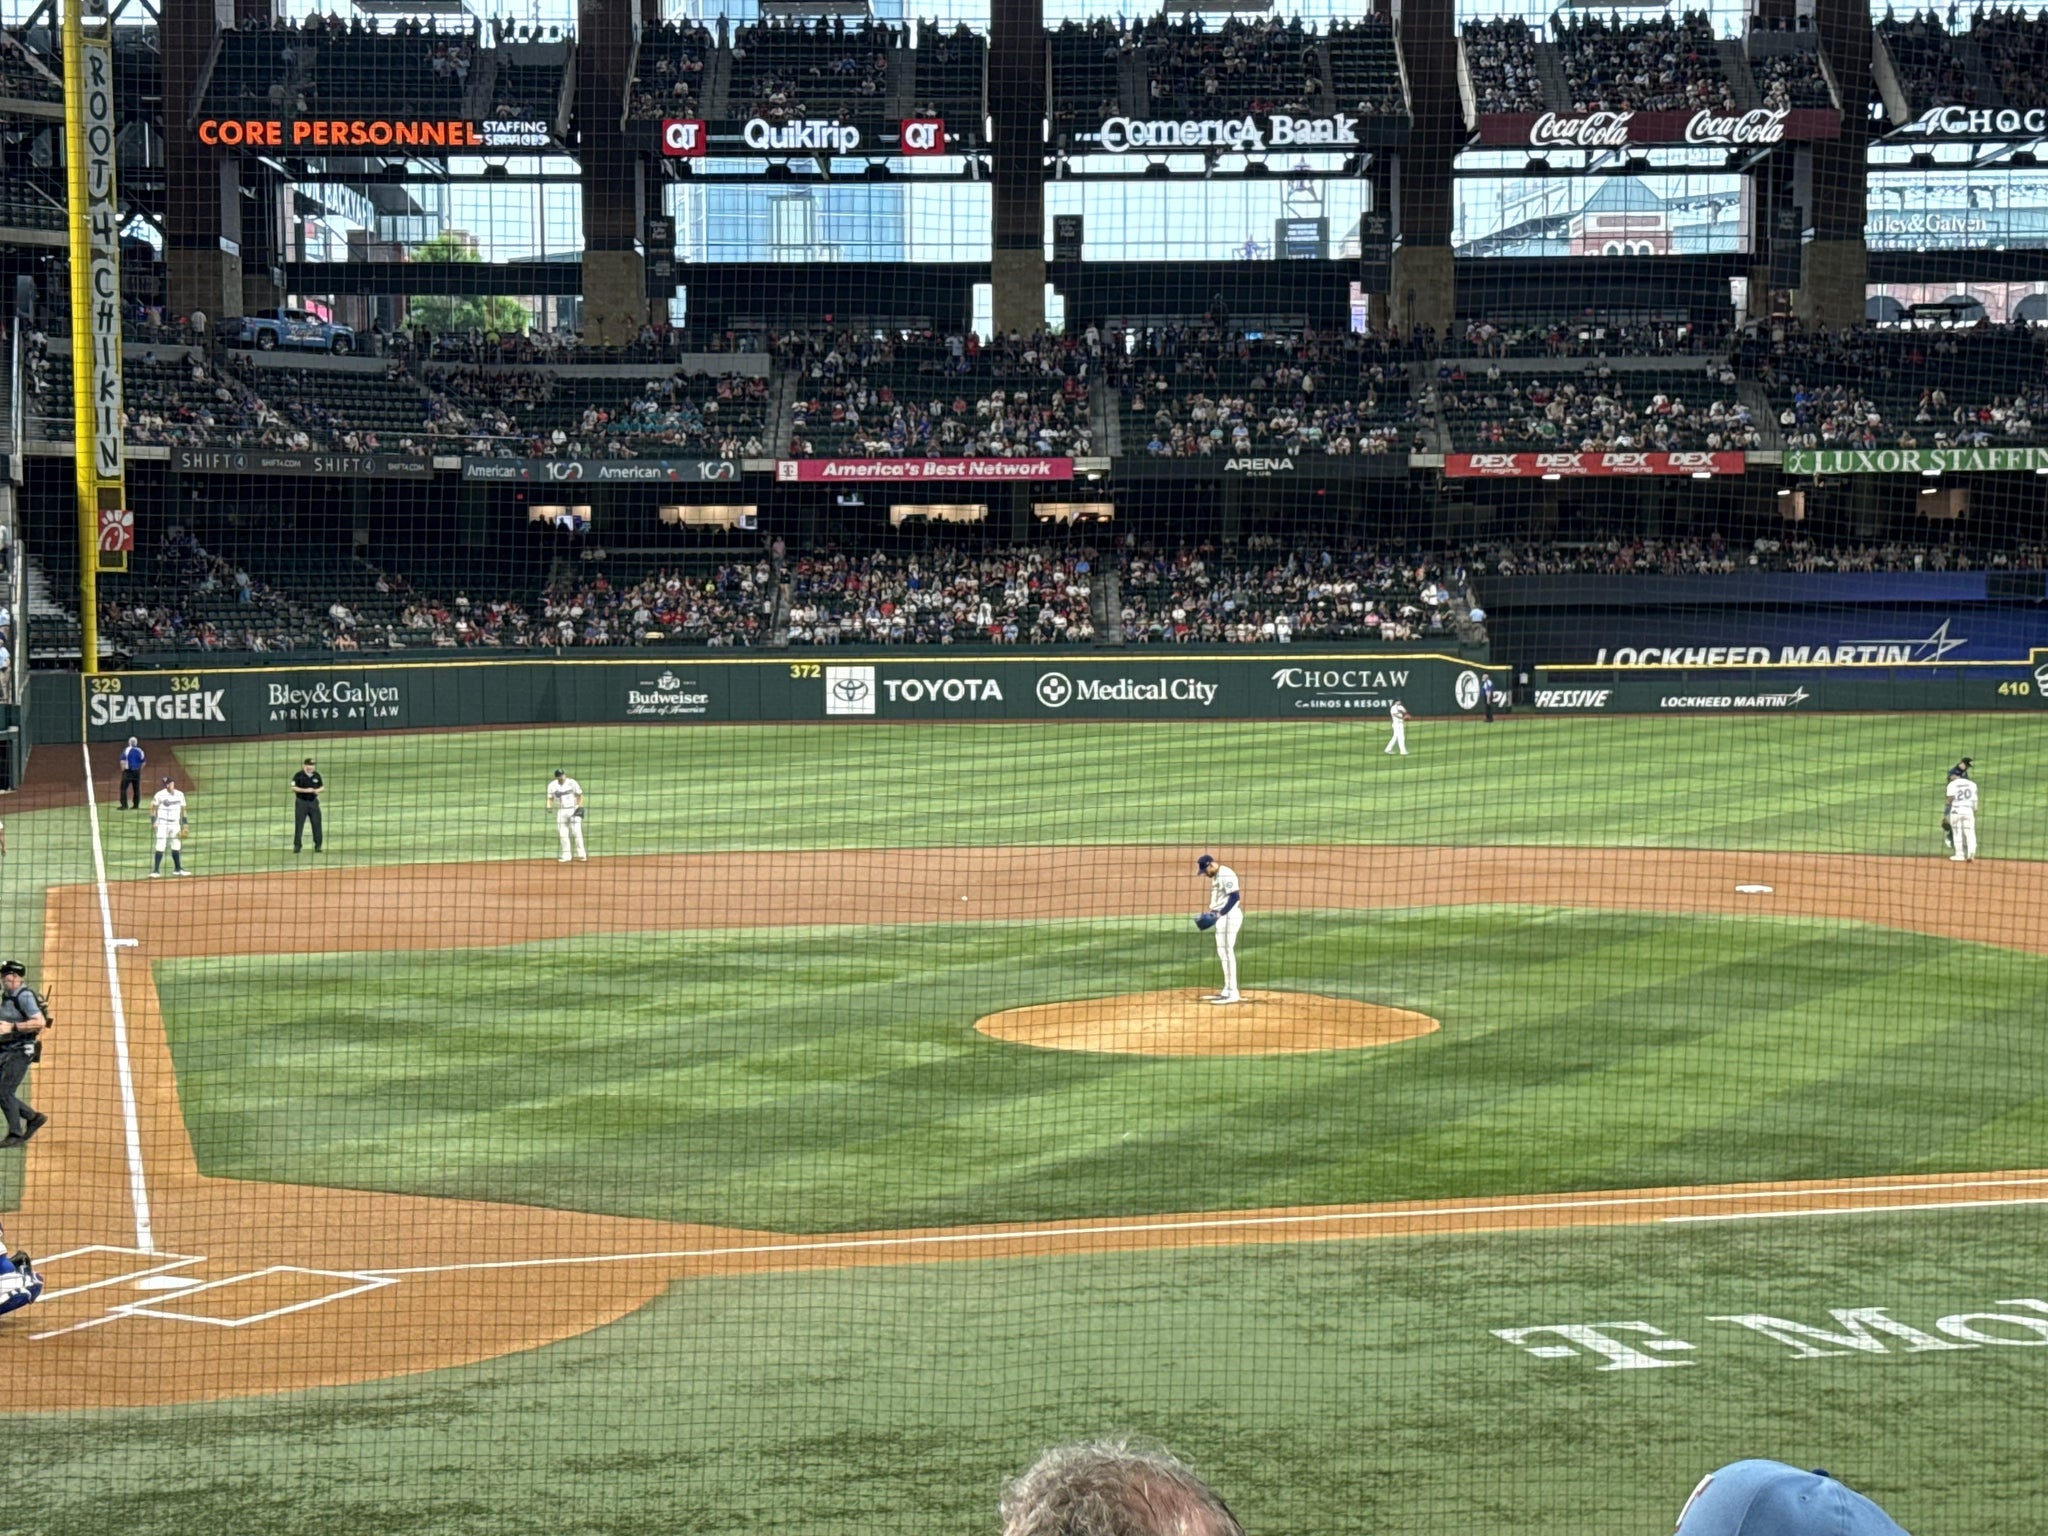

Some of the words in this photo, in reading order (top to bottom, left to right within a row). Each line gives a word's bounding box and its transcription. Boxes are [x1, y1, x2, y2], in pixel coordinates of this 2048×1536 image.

[199, 120, 282, 145] CORE
[293, 120, 481, 146] PERSONNEL
[482, 121, 548, 133] STAFFING
[1269, 113, 1360, 145] Bank
[1530, 110, 1634, 146] Coca-Cola
[1685, 108, 1791, 145] Coca-Cola
[666, 123, 699, 150] QT
[744, 118, 860, 153] QuikTrip
[905, 122, 938, 150] QT
[94, 267, 119, 469] CHIKIN
[1223, 457, 1295, 471] ARENA
[1469, 454, 1518, 468] DEX
[1535, 453, 1584, 467] DEX
[1601, 452, 1651, 467] DEX
[1667, 452, 1717, 466] DEX
[1813, 450, 1921, 472] LUXOR
[467, 464, 517, 478] American
[598, 465, 661, 479] American
[822, 461, 919, 477] America's
[922, 461, 964, 476] Best
[968, 461, 1052, 476] Network
[790, 665, 821, 678] 372
[1285, 668, 1410, 688] CHOCTAW
[90, 678, 122, 693] 329
[170, 676, 200, 691] 334
[883, 678, 1004, 702] TOYOTA
[1997, 681, 2030, 696] 410
[628, 690, 708, 705] Budweiser
[1076, 678, 1168, 701] Medical
[1170, 678, 1219, 706] City
[90, 688, 227, 726] SEATGEEK
[1660, 696, 1732, 707] LOCKHEED
[1732, 695, 1787, 707] MARTIN
[348, 707, 366, 718] AT
[373, 706, 399, 718] LAW
[1957, 788, 1973, 801] 20
